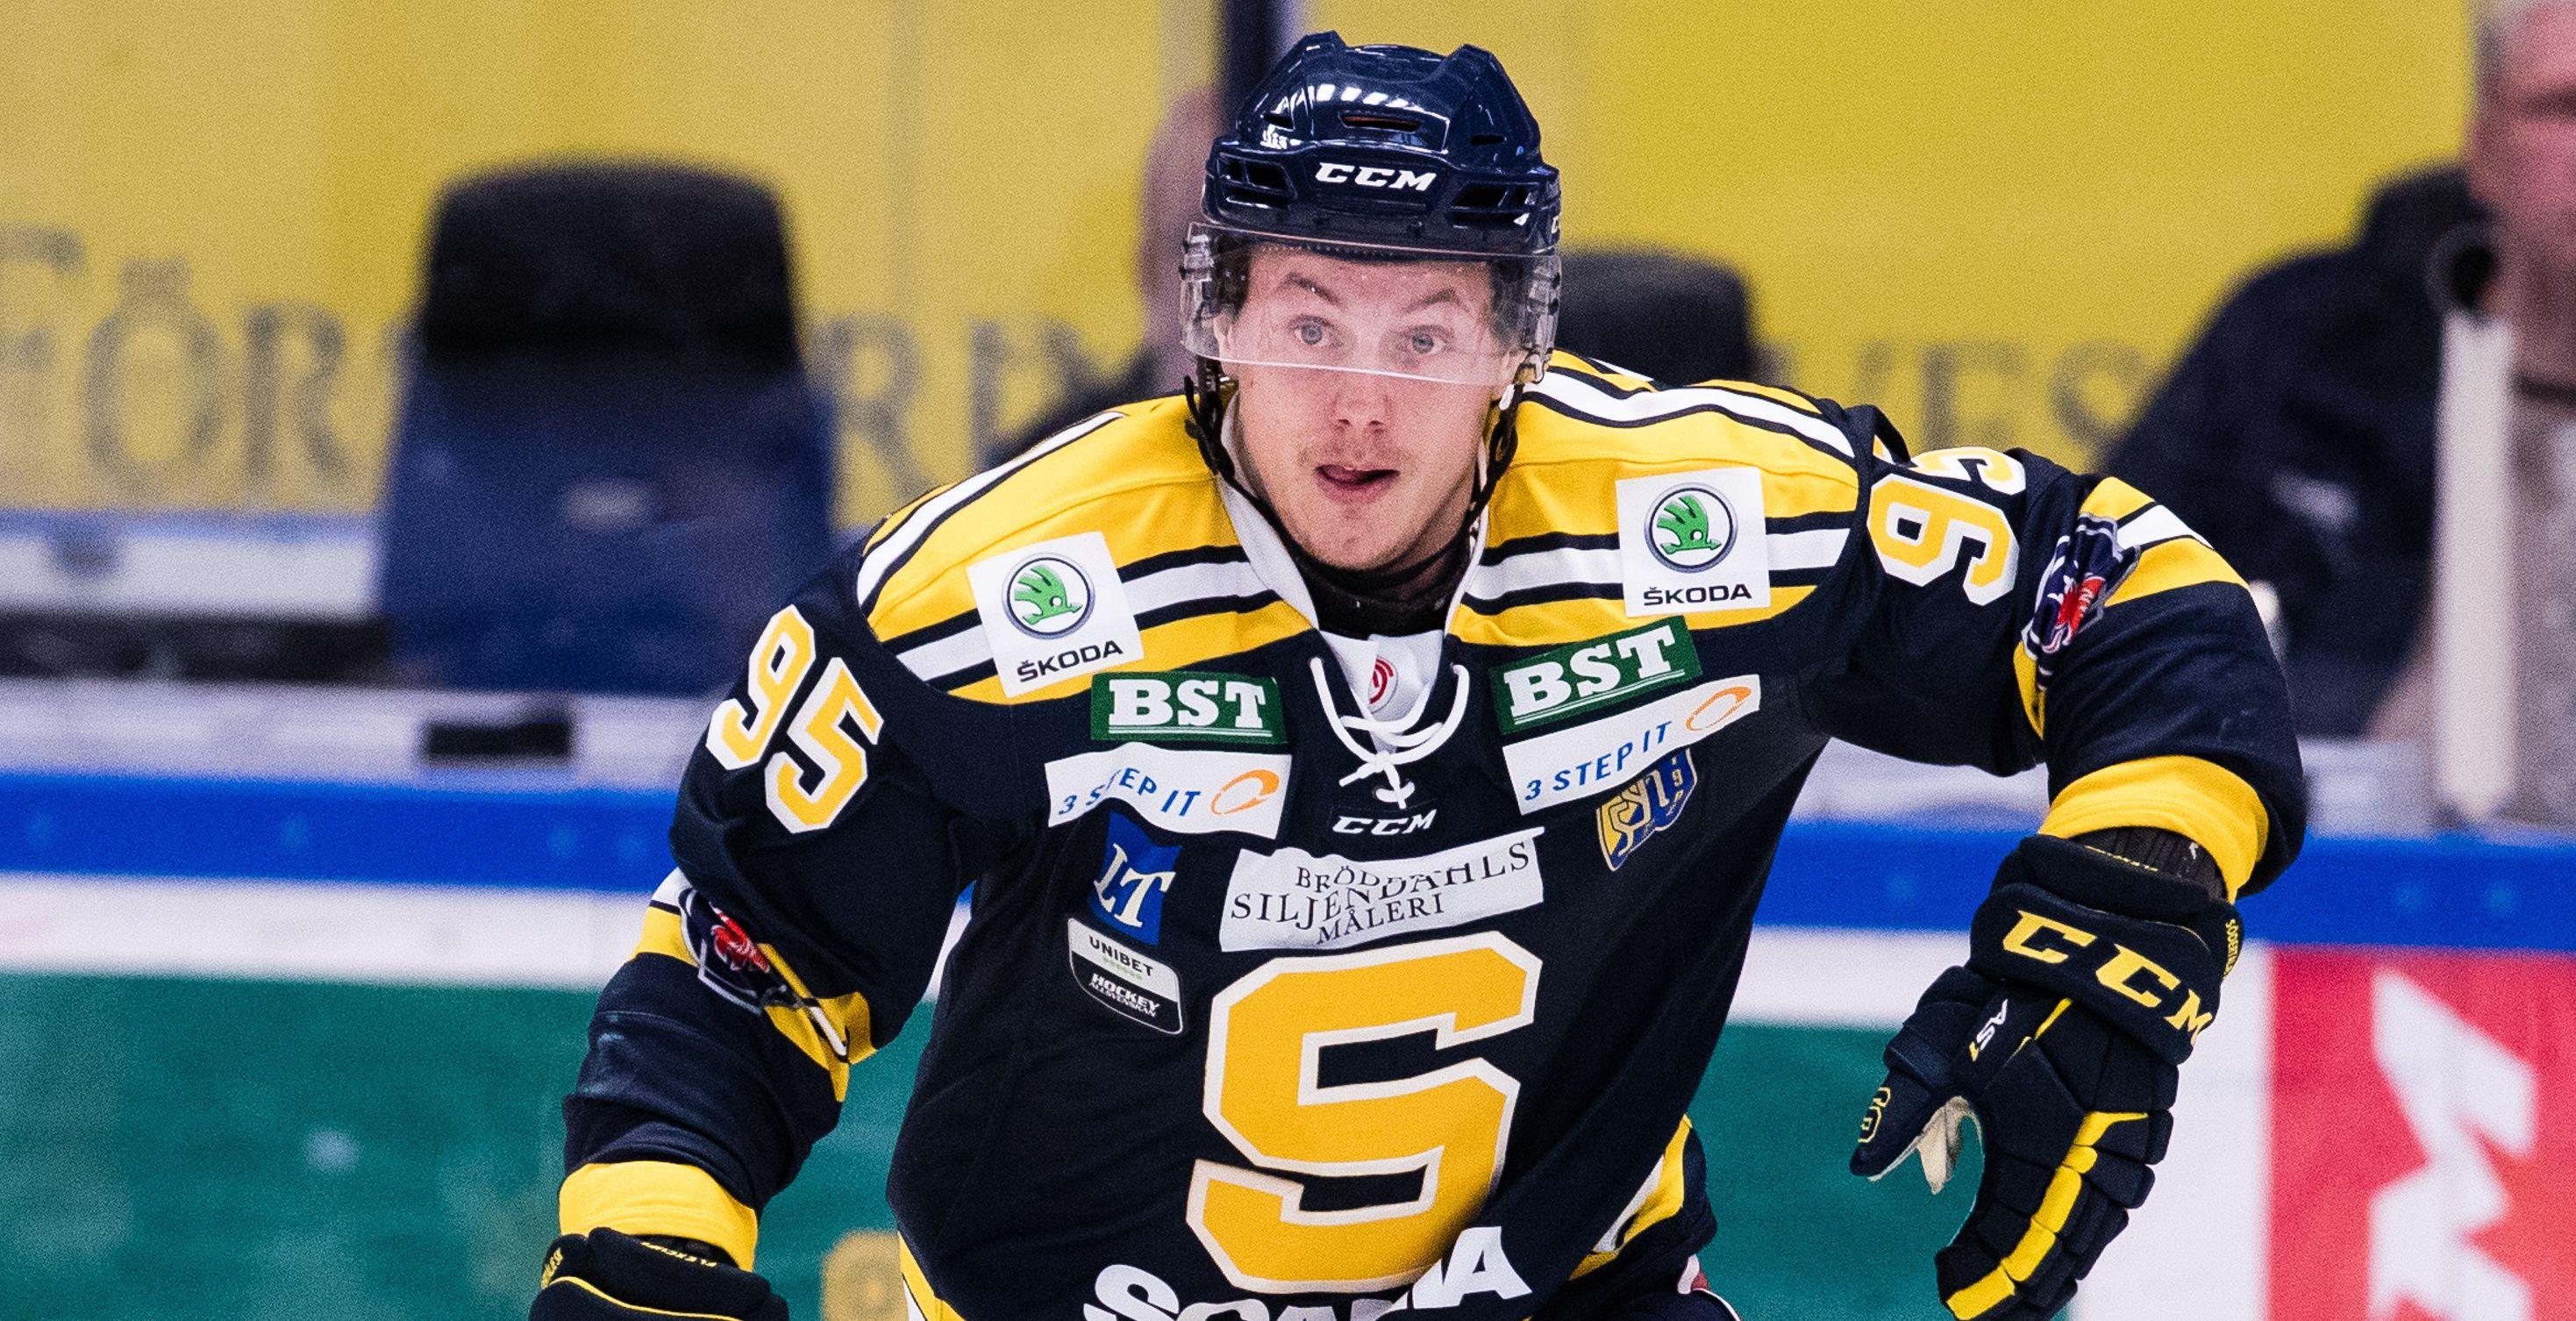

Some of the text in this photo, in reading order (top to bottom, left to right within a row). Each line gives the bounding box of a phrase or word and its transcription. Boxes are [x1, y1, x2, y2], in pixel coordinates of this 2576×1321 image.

[1316, 161, 1437, 191] CCM
[1644, 582, 1752, 606] ŠKODA
[1017, 639, 1124, 682] ŠKODA
[1503, 625, 1676, 717] BST
[705, 603, 884, 833] 95
[1108, 678, 1267, 729] BST
[1524, 720, 1673, 802] 3 STEP IT
[1058, 767, 1202, 818] 3 SEP IT
[1331, 809, 1438, 836] CCM
[1093, 842, 1177, 928] LT
[1317, 892, 1445, 945] MÅLERI
[1088, 933, 1153, 977] UNIBET
[2002, 909, 2214, 1048] CCM
[1090, 972, 1160, 1011] HOCKEY
[1186, 931, 1543, 1295] S
